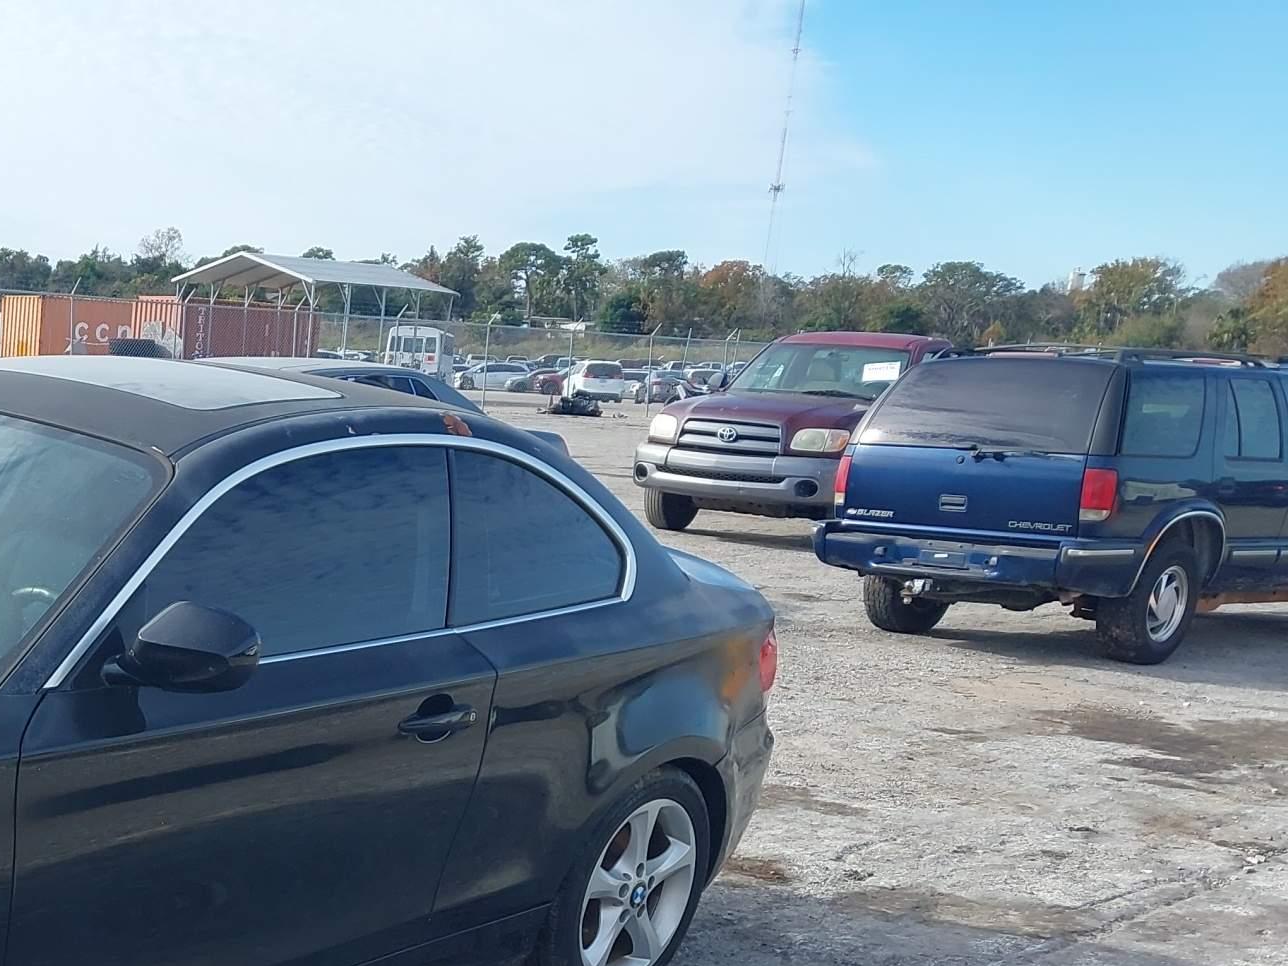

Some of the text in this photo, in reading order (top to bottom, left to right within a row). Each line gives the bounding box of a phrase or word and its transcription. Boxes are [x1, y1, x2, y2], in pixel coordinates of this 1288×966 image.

[195, 306, 206, 352] TRITO
[856, 508, 895, 518] BLAZER
[1008, 520, 1073, 534] CHEVROLET
